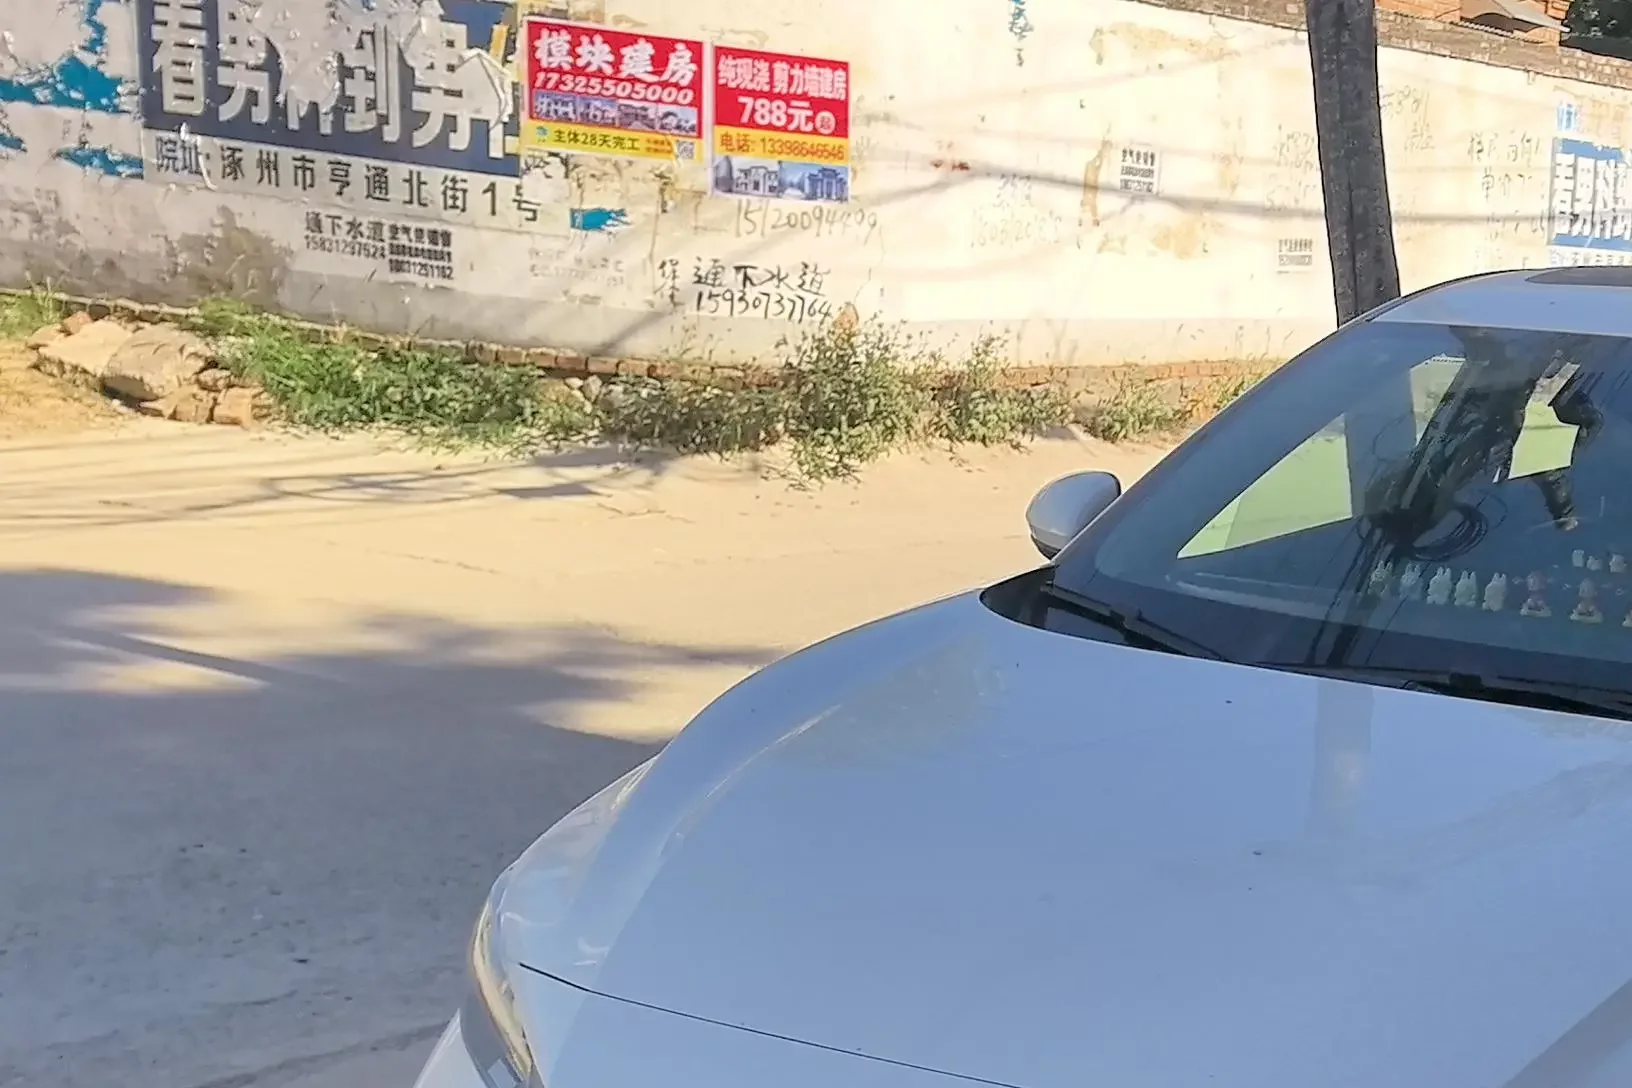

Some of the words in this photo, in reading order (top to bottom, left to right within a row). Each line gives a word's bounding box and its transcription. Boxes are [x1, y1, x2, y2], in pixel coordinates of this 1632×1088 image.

[533, 28, 698, 87] 模块建房
[534, 71, 694, 106] 17325505000
[692, 256, 832, 297] 通下水道
